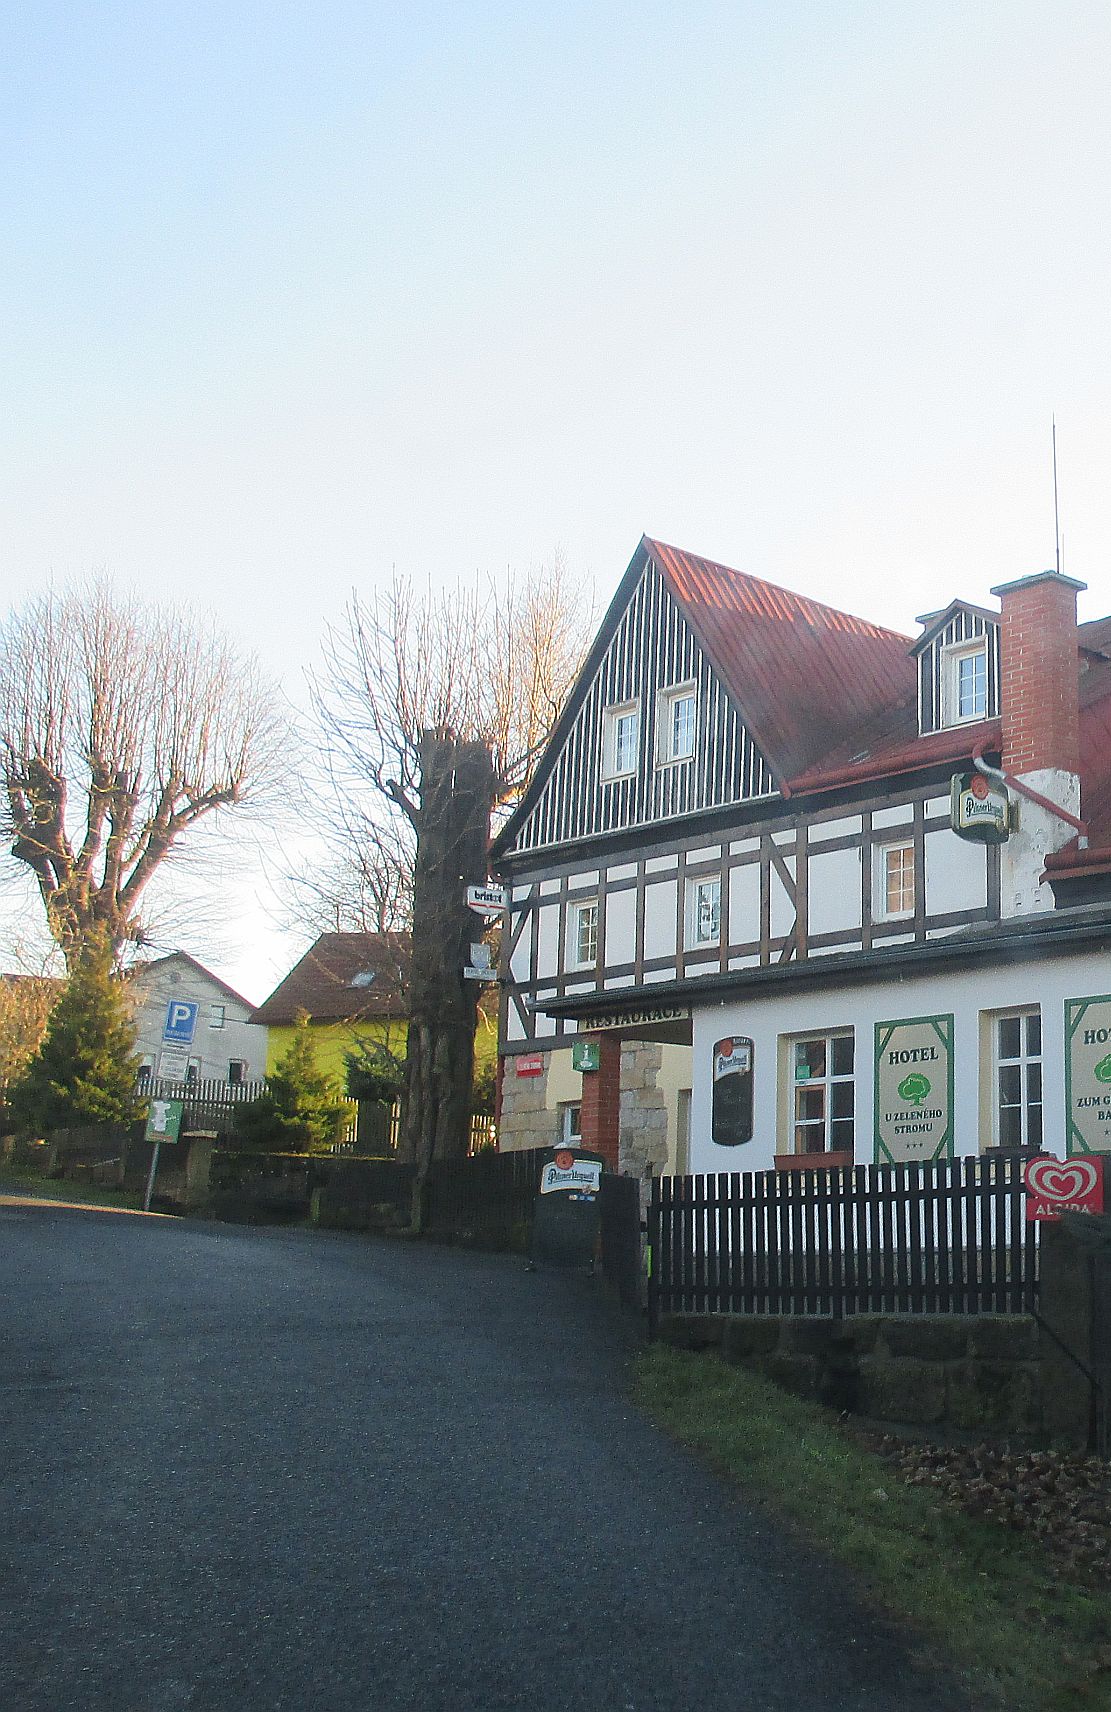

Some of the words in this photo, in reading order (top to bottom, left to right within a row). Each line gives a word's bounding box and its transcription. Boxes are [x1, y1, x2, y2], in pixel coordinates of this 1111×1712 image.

[171, 1005, 191, 1028] P
[586, 1008, 681, 1029] RESTAURACE
[889, 1046, 939, 1065] HOTEL
[1077, 1096, 1101, 1107] ZUM
[885, 1113, 892, 1121] U
[893, 1107, 943, 1121] ZELENÉHO
[894, 1123, 933, 1135] STROMU
